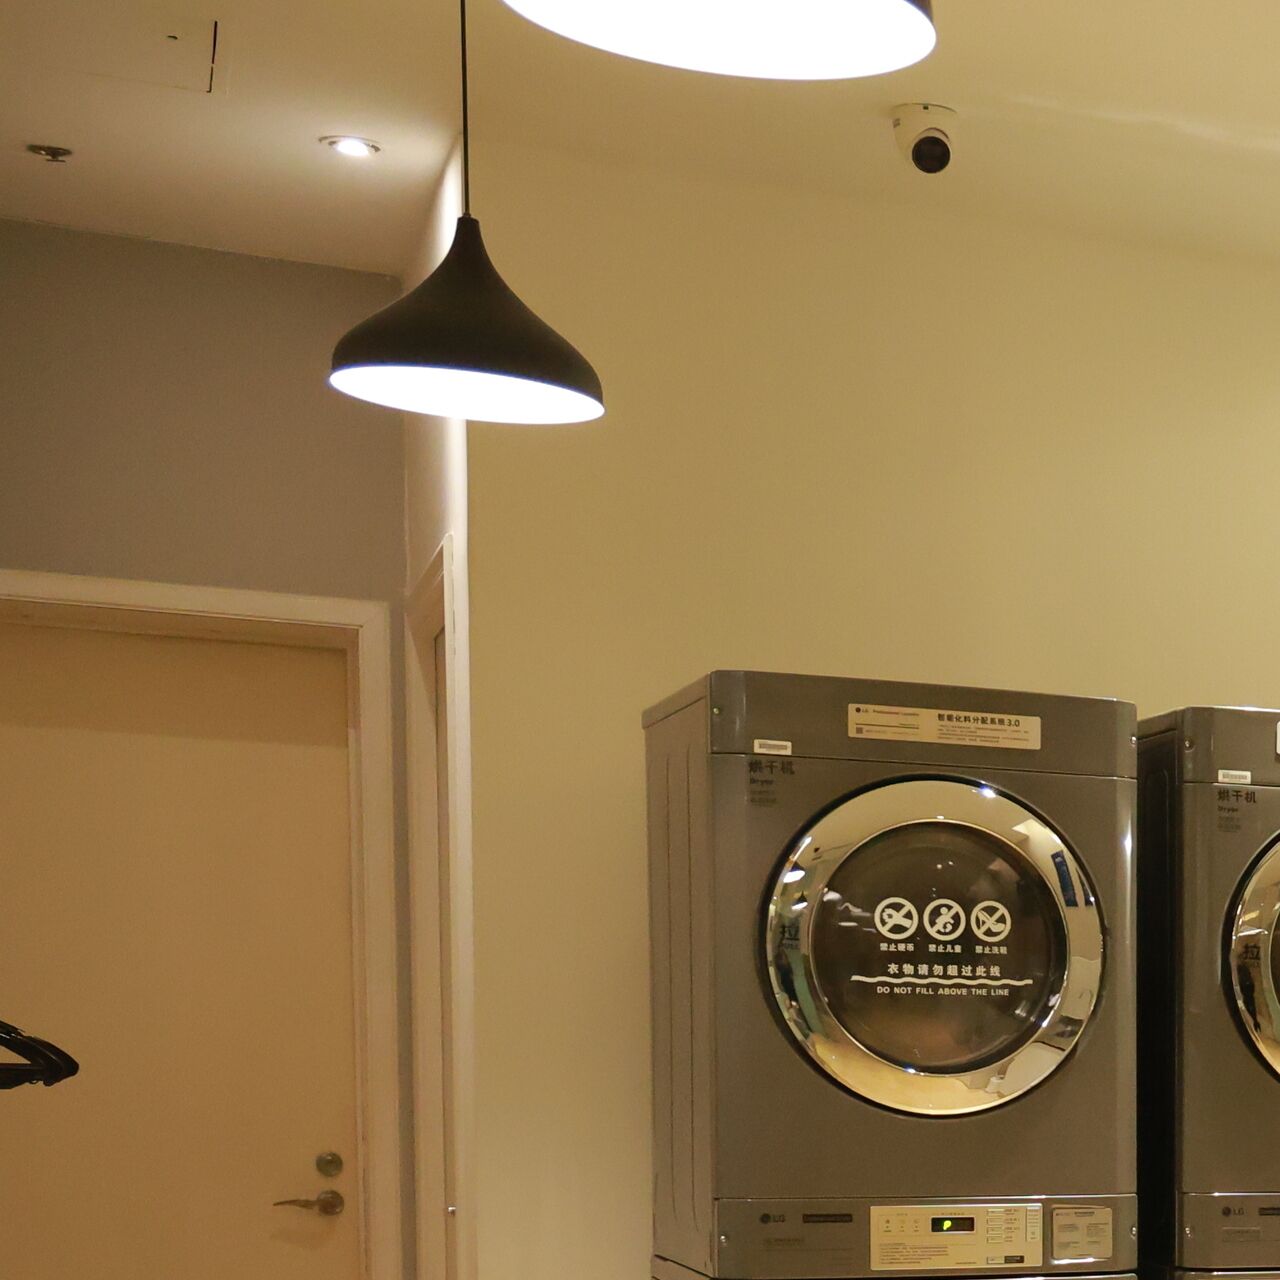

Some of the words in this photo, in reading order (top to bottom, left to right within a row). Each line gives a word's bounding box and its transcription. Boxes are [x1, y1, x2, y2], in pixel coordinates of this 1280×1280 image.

[1218, 789, 1256, 803] 烘干机
[880, 943, 914, 951] 禁止硬币
[929, 944, 961, 953] 禁止儿童
[884, 963, 1000, 980] 衣物请勿超过此线
